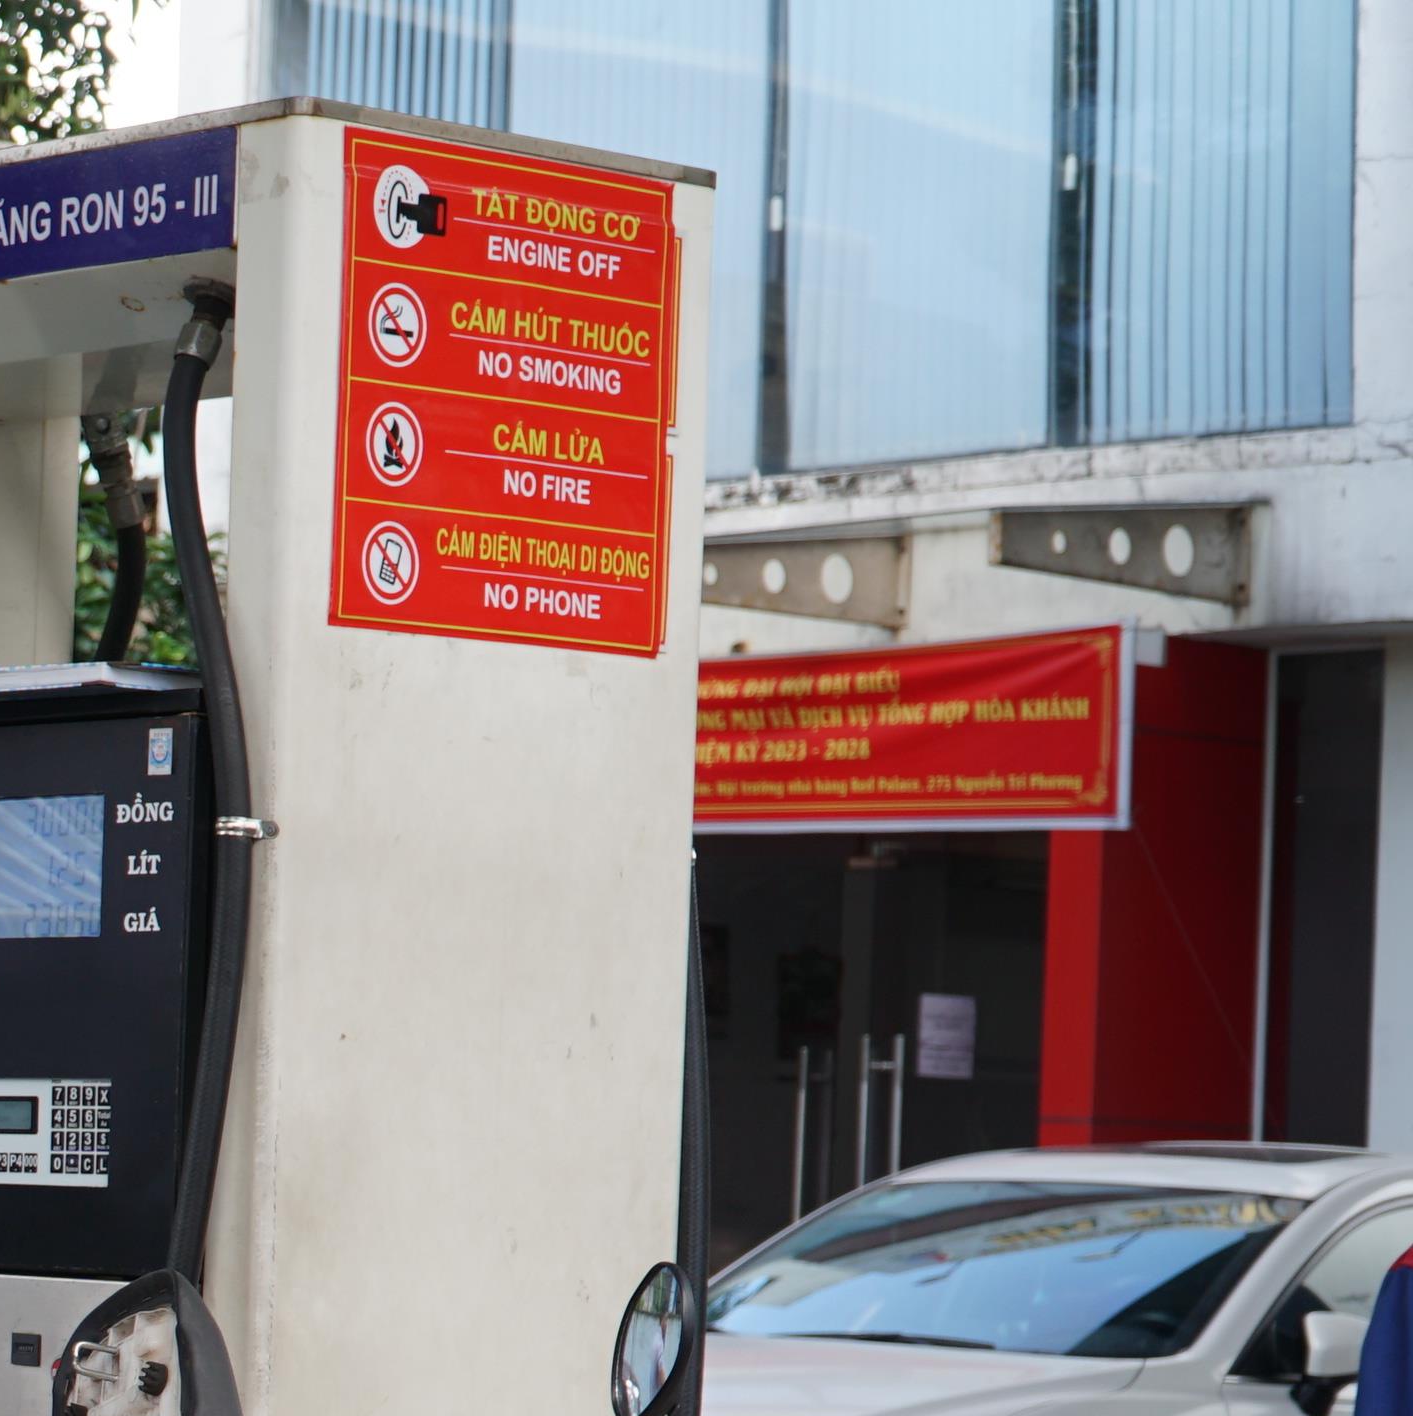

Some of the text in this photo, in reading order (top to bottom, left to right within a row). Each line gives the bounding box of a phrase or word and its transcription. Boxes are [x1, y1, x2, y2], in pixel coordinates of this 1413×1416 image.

[61, 189, 126, 237] RON
[133, 184, 167, 226] 95
[194, 175, 218, 217] III
[472, 187, 641, 241] TẮT ĐỘNG CƠ
[487, 236, 621, 280] ENGINE OFF
[451, 299, 650, 358] CẤM HÚT THUỐC
[478, 350, 621, 395] NO SMOKING
[493, 422, 604, 465] CẤM LỬA
[503, 469, 591, 504] NO FIRE
[436, 524, 650, 581] CẤM ĐIỆN THOẠI DI ĐỘNG
[484, 583, 600, 620] NO PHONE
[116, 793, 174, 823] ĐỒNG
[127, 849, 161, 875] LÍT
[124, 907, 160, 932] GIÁ
